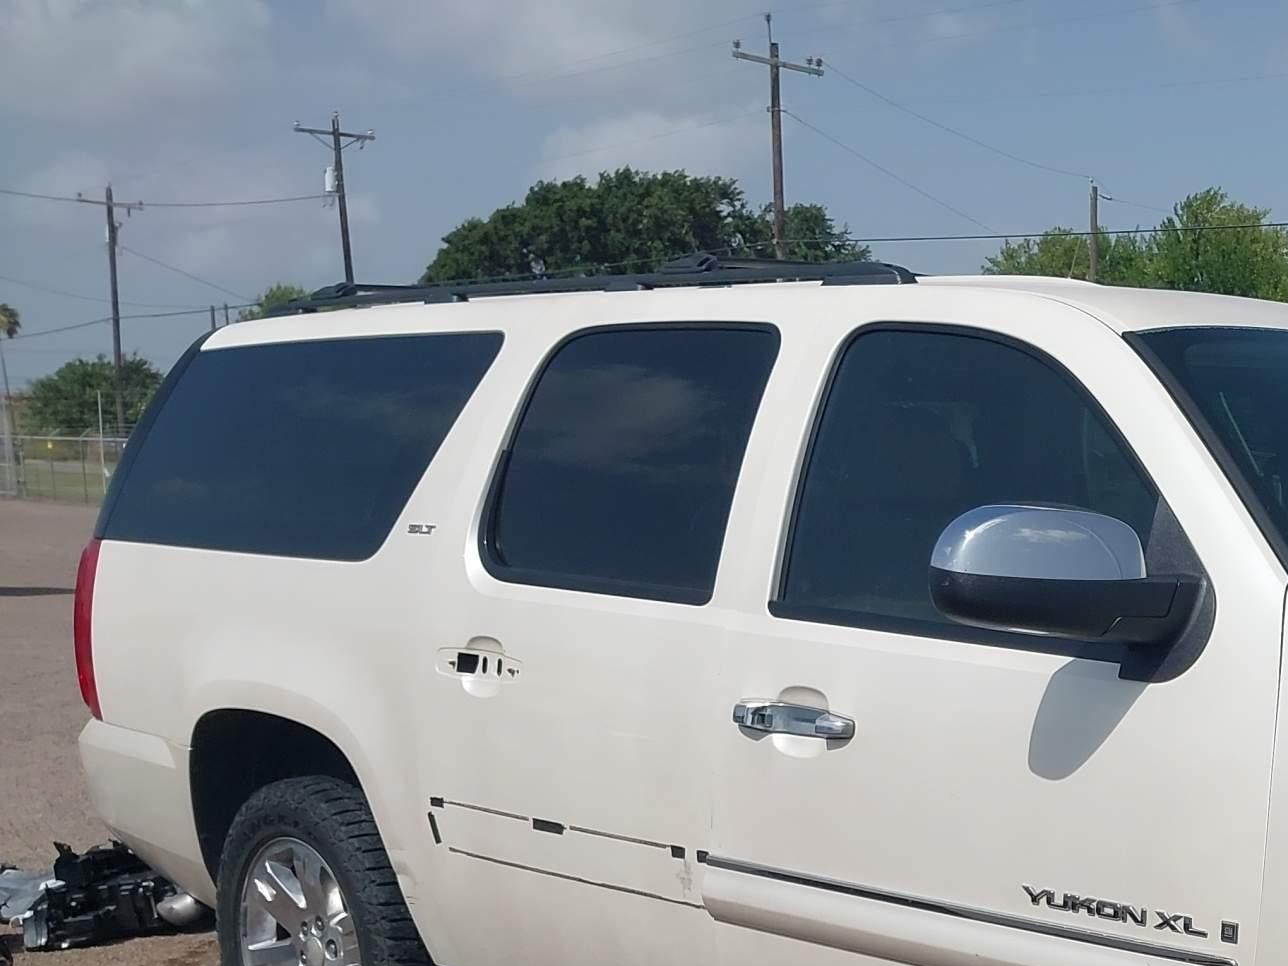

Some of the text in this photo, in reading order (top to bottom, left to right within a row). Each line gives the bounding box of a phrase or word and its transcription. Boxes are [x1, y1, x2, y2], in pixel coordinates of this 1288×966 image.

[408, 524, 436, 535] SLT
[1022, 884, 1208, 938] YUKON XL
